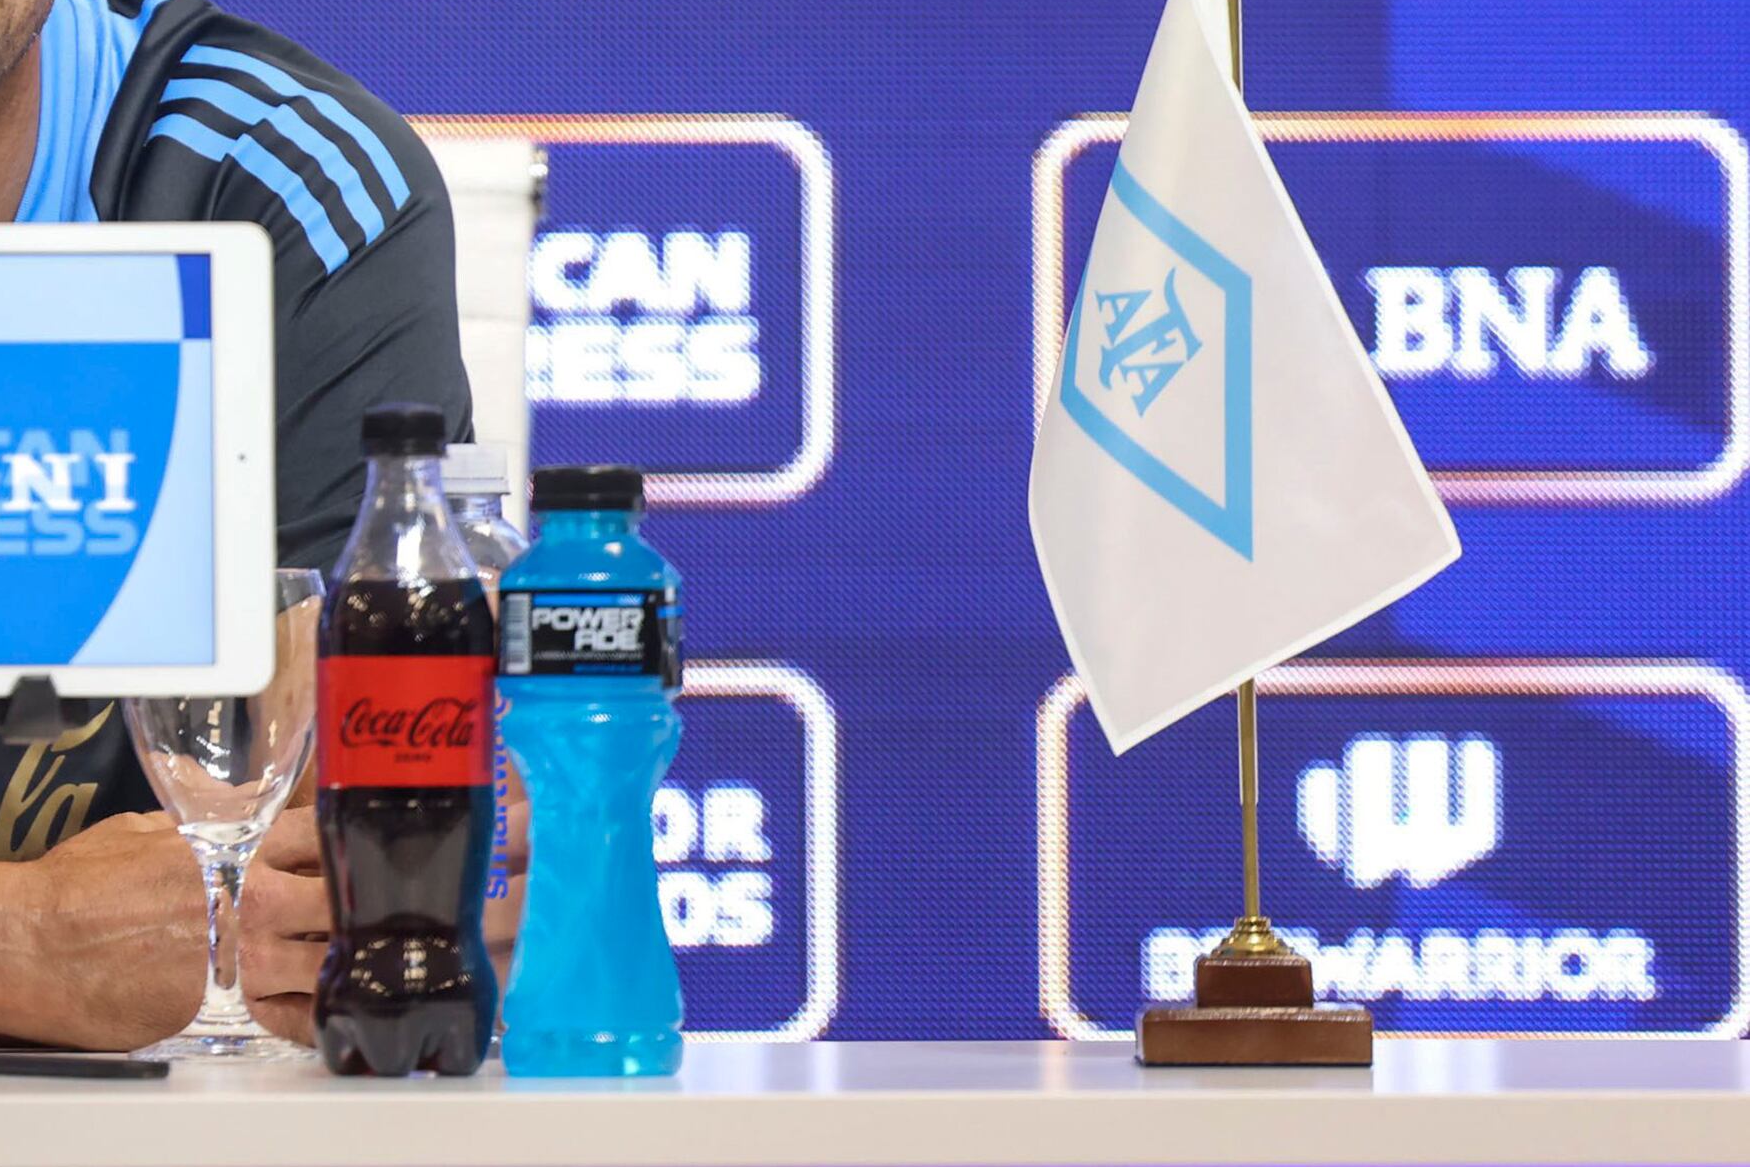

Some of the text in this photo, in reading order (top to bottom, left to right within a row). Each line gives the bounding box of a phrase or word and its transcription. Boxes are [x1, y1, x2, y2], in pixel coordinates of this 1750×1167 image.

[527, 224, 753, 316] CAN
[1362, 265, 1657, 380] BNA
[531, 607, 645, 632] POWER
[340, 697, 480, 749] Coca-Cola
[1141, 928, 1656, 1002] BWARRIOR
